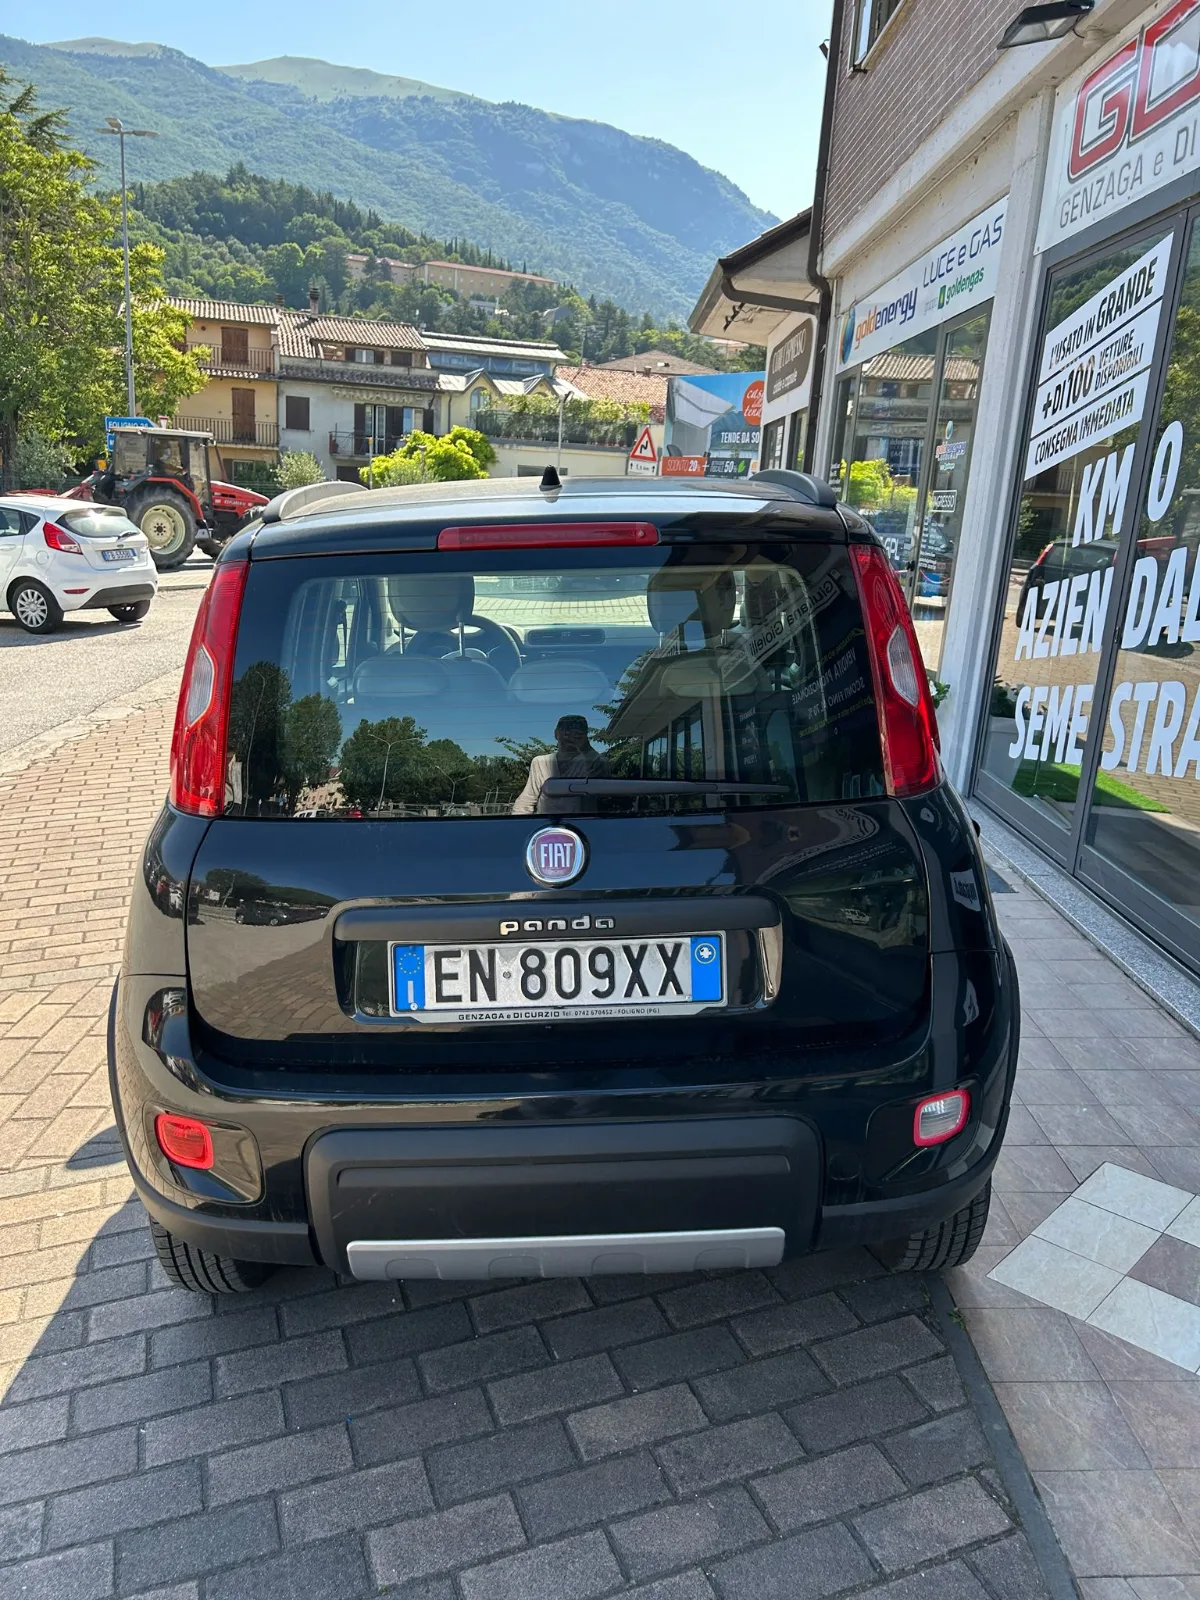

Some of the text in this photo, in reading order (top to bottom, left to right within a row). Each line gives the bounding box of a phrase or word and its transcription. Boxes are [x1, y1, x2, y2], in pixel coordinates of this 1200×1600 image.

[1059, 119, 1198, 228] GENZAGA e DI
[922, 213, 1004, 288] LUCE e GAS
[945, 267, 985, 305] goldengas
[1049, 256, 1158, 370] L'USATO IN GRANDE
[854, 287, 918, 350] goldenergy
[1094, 343, 1144, 391] DISPONIBILI
[1099, 328, 1135, 369] VETTURE
[1065, 354, 1096, 409] 100
[720, 432, 741, 443] TENDE
[741, 432, 751, 443] DA
[1034, 387, 1135, 465] CONSEGNA IMMEDIATA
[1072, 442, 1135, 548] KM
[540, 843, 573, 868] FIAT
[500, 915, 615, 936] panda
[434, 948, 499, 1004] EN
[520, 942, 685, 1001] 809XX
[458, 1012, 505, 1021] GENZAGA
[524, 1011, 560, 1019] CURZIO
[646, 1007, 660, 1015] (PG)
